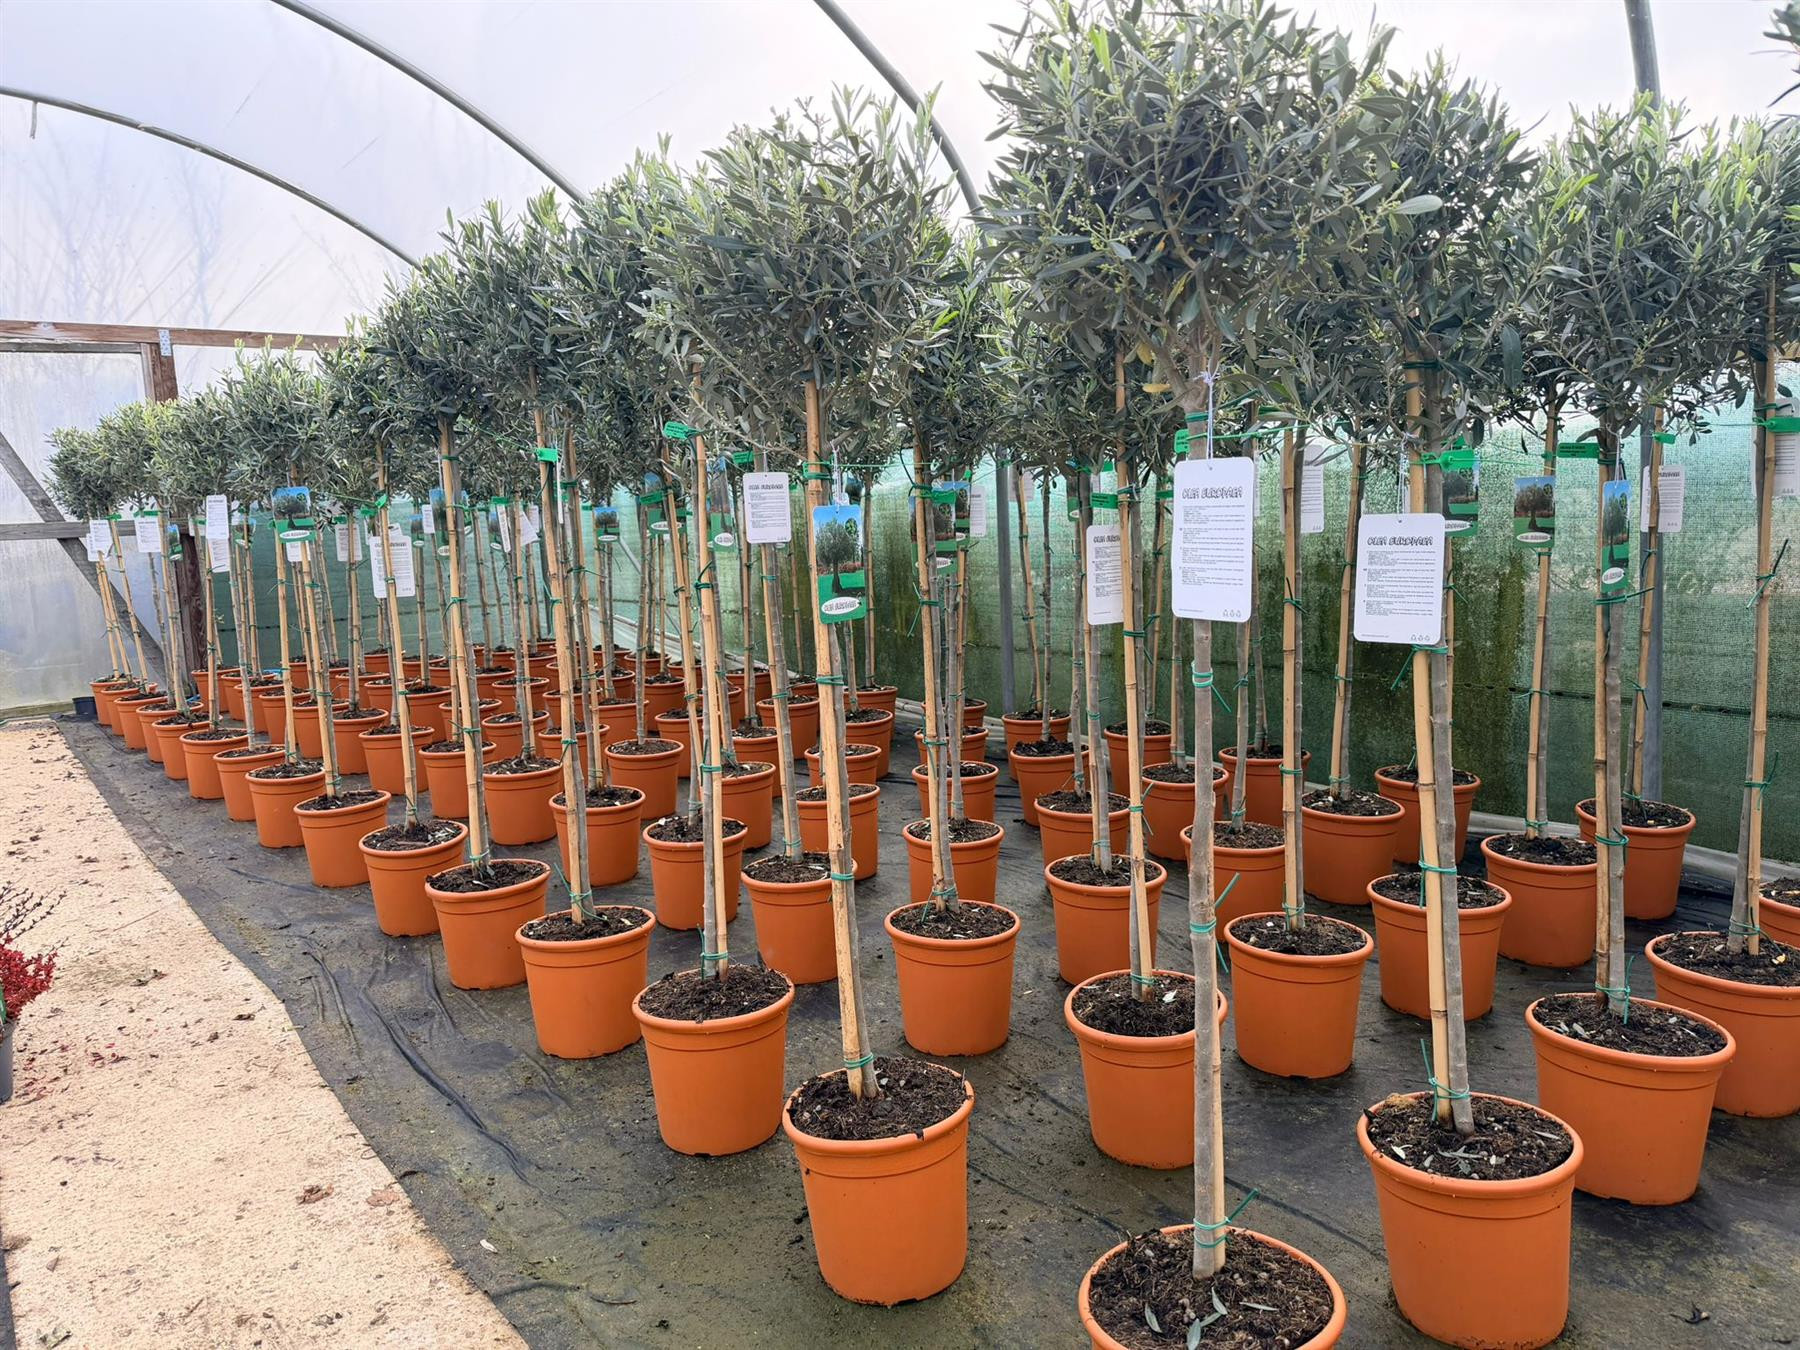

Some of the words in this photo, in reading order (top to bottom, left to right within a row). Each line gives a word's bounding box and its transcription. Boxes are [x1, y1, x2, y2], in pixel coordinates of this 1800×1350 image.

[1182, 487, 1199, 499] OLEA
[1201, 486, 1243, 499] EUROPAEA
[1367, 535, 1387, 546] OLEA
[1388, 535, 1434, 546] EUROPAEA
